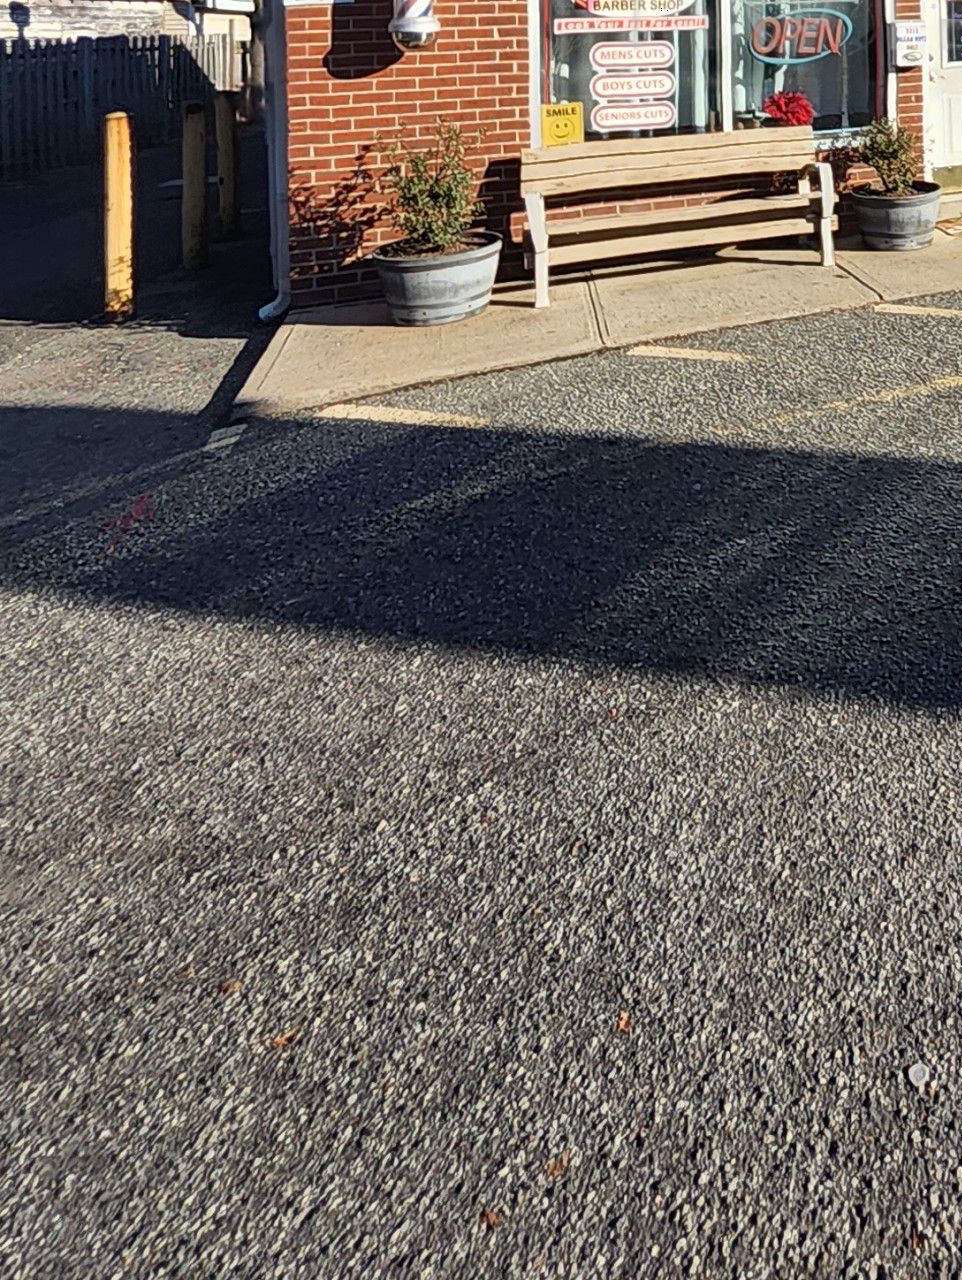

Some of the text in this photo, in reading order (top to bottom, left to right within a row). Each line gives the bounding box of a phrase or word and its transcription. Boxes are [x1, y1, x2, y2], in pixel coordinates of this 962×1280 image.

[593, 0, 684, 12] BARBER SHOP
[752, 16, 843, 55] OPEN
[600, 49, 666, 60] MENS CUTS
[602, 79, 666, 91] BOYS CUTS
[545, 106, 577, 118] SMILE
[598, 109, 669, 122] SENIORS CUTS
